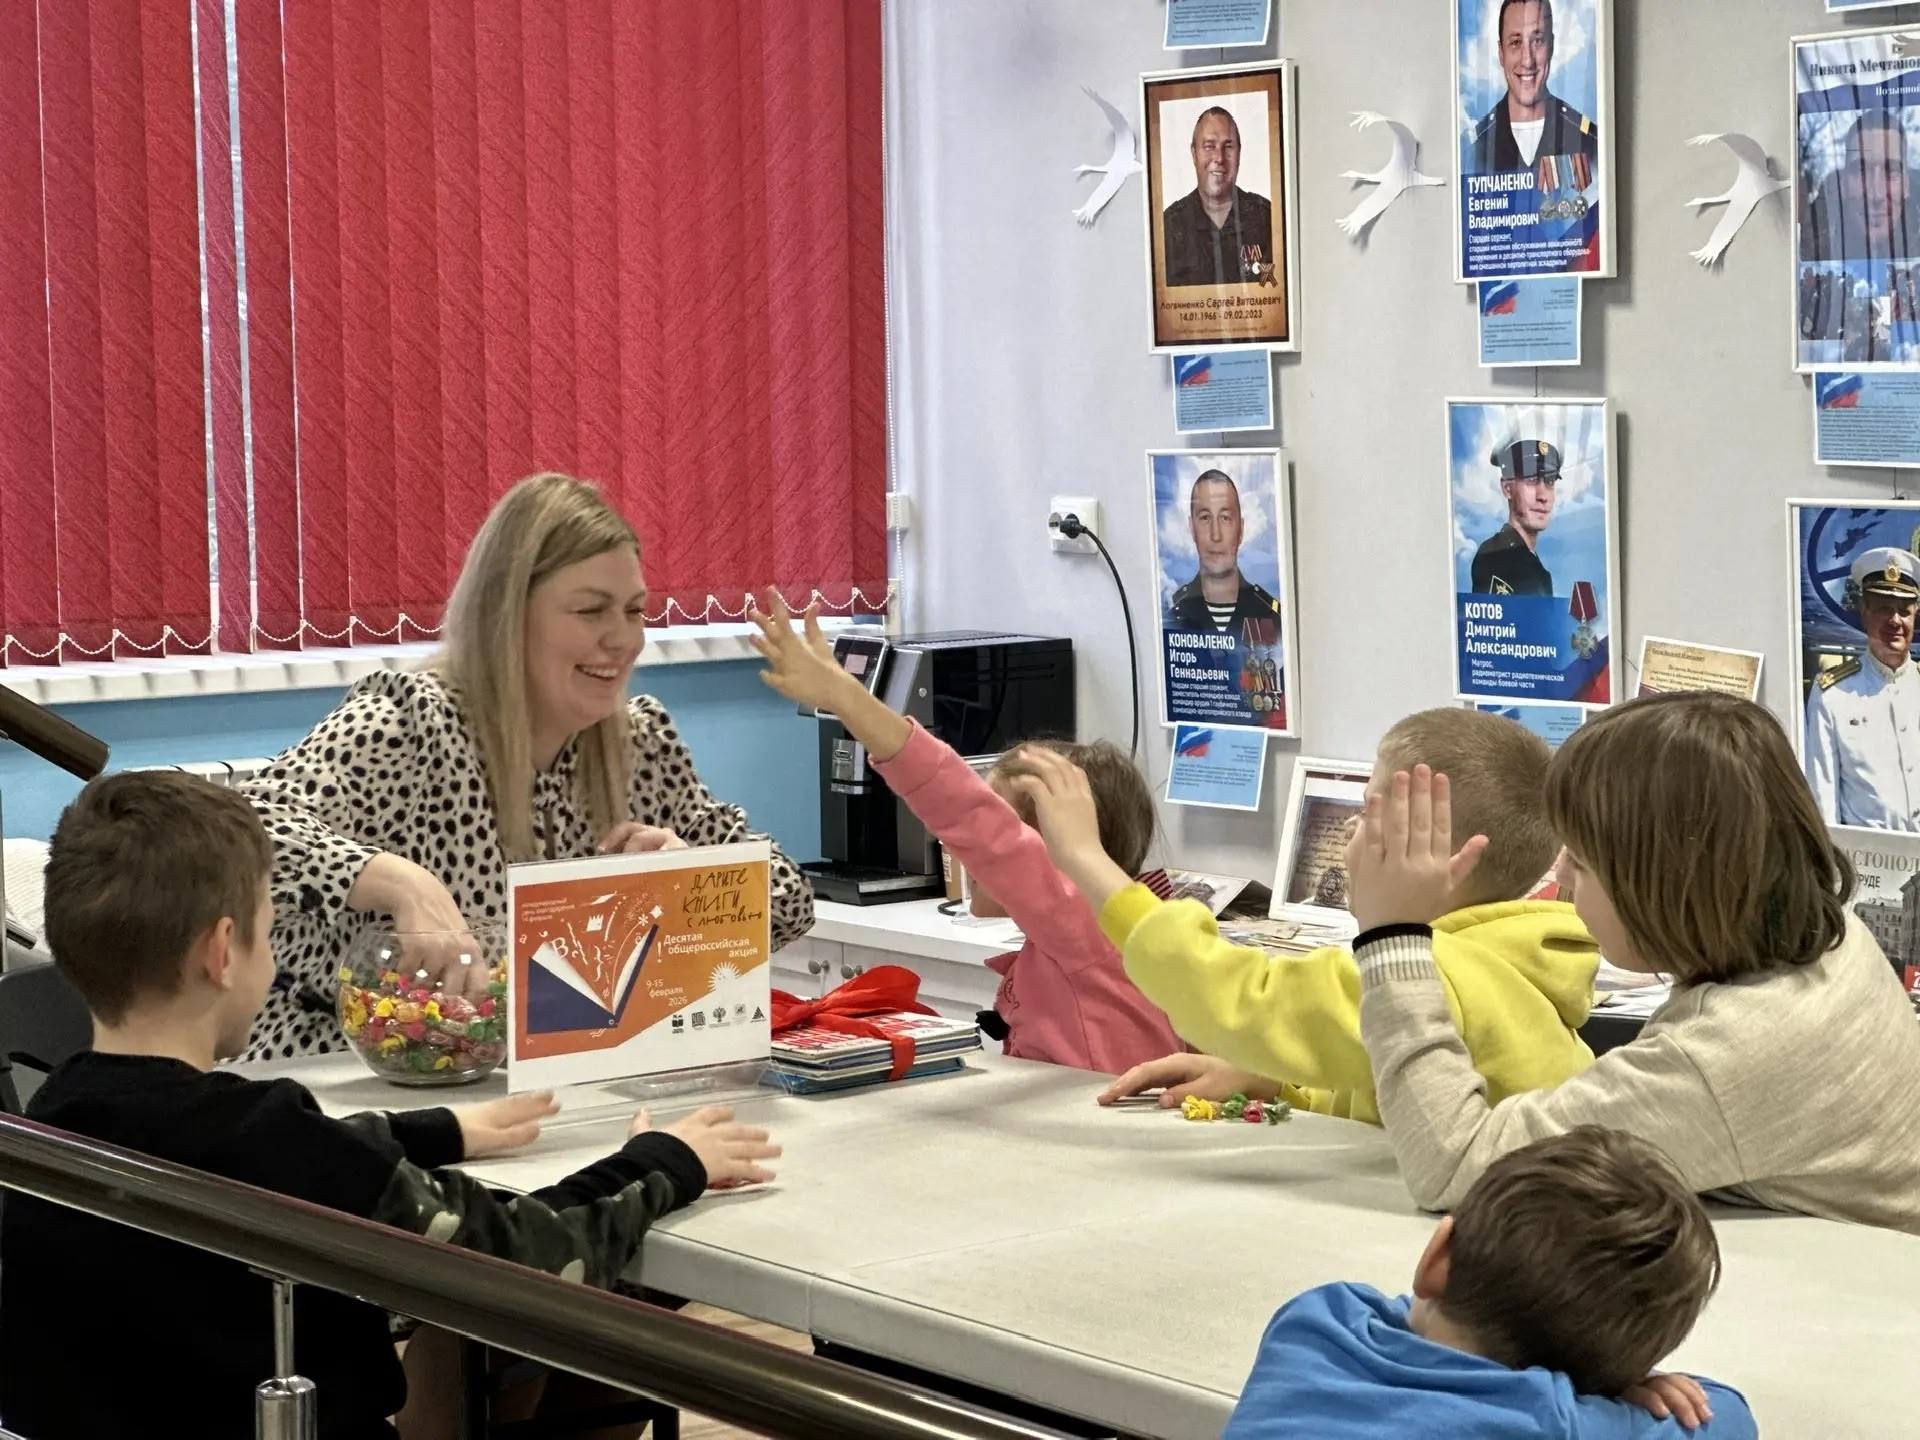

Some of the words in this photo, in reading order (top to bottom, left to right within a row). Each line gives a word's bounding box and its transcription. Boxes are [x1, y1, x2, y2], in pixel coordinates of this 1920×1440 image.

[1809, 63, 1857, 76] Никита
[1468, 172, 1534, 194] ТУПЧАНЕНКО
[1468, 194, 1509, 212] Евгений
[1468, 213, 1539, 230] Владимирович
[1206, 296, 1236, 310] Сергей
[1180, 312, 1217, 321] 14.01.1966
[1224, 309, 1263, 320] 09.02.2023
[1465, 602, 1503, 620] КОТОВ
[1465, 621, 1516, 640] Дмитрий
[1168, 633, 1235, 650] КОНОВАЛЕНКО
[1466, 638, 1557, 660] Александрович
[1170, 649, 1197, 666] Игорь
[1170, 664, 1230, 681] Геннадьевич
[1498, 679, 1518, 688] боевой
[663, 932, 703, 946] Десятая
[668, 938, 750, 955] общероссийская
[728, 947, 758, 959] акция
[646, 978, 664, 988] 9-15
[649, 986, 684, 998] февраля
[668, 996, 688, 1007] 2026
